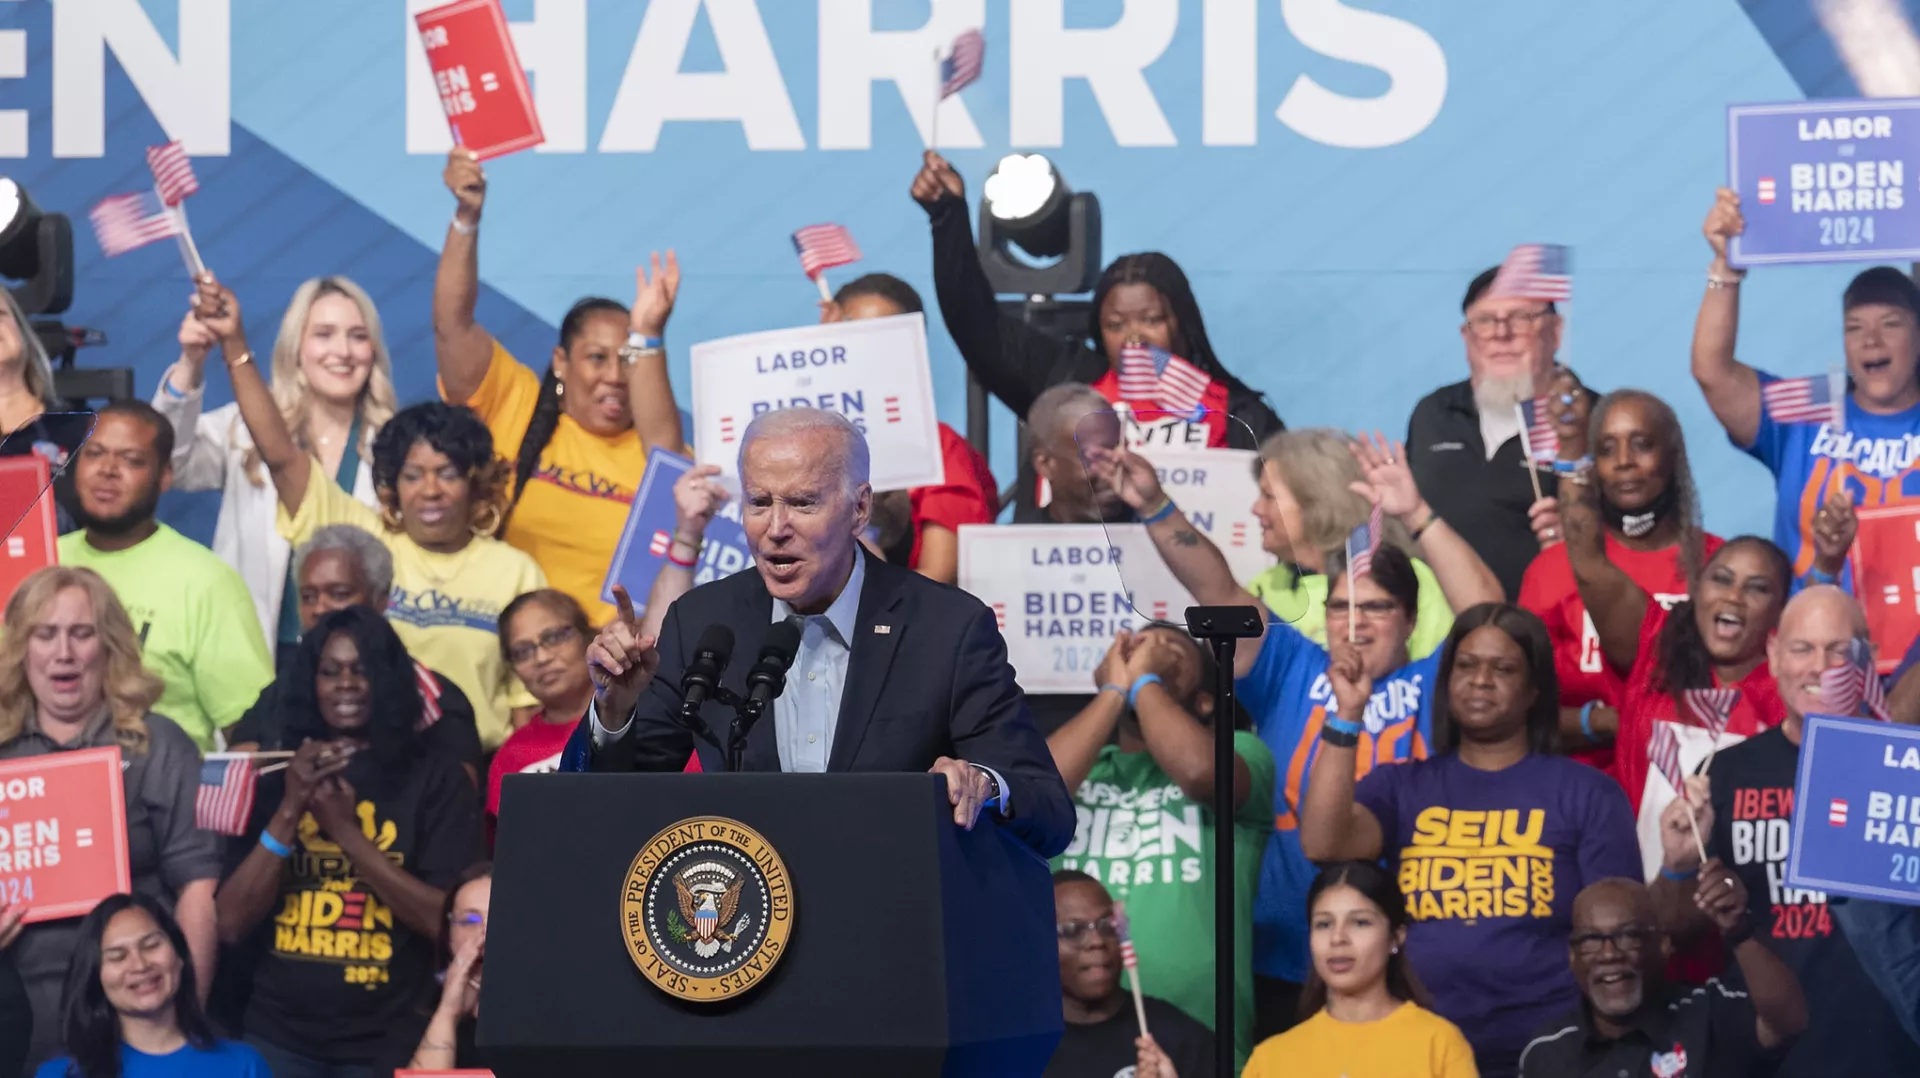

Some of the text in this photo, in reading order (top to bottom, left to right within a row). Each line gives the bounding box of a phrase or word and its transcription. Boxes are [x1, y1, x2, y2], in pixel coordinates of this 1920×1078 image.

[0, 0, 1447, 157] N HARRIS
[1798, 116, 1892, 141] LABOR
[1790, 160, 1904, 191] BIDEN
[1791, 187, 1904, 213] HARRIS
[1819, 216, 1875, 246] 2024
[755, 346, 848, 374] LABOR
[1157, 467, 1207, 485] BOR
[1032, 546, 1123, 565] LABOR
[1024, 592, 1135, 615] BIDEN
[1024, 619, 1134, 637] HARRIS
[1732, 788, 1795, 820] IBEW
[1063, 804, 1201, 861] BIDEN
[1411, 805, 1546, 848] SEIU
[1731, 818, 1790, 865] BID
[1398, 856, 1529, 894] BIDEN
[1530, 857, 1554, 919] 2024
[275, 889, 393, 931] BIDEN
[627, 823, 788, 994] SEAL OF THE PRESIDENT OF THE UNITED STATES
[1405, 887, 1529, 921] HARRIS
[1772, 904, 1832, 938] 2024
[275, 926, 393, 961] HARRIS
[344, 965, 389, 984] 2024
